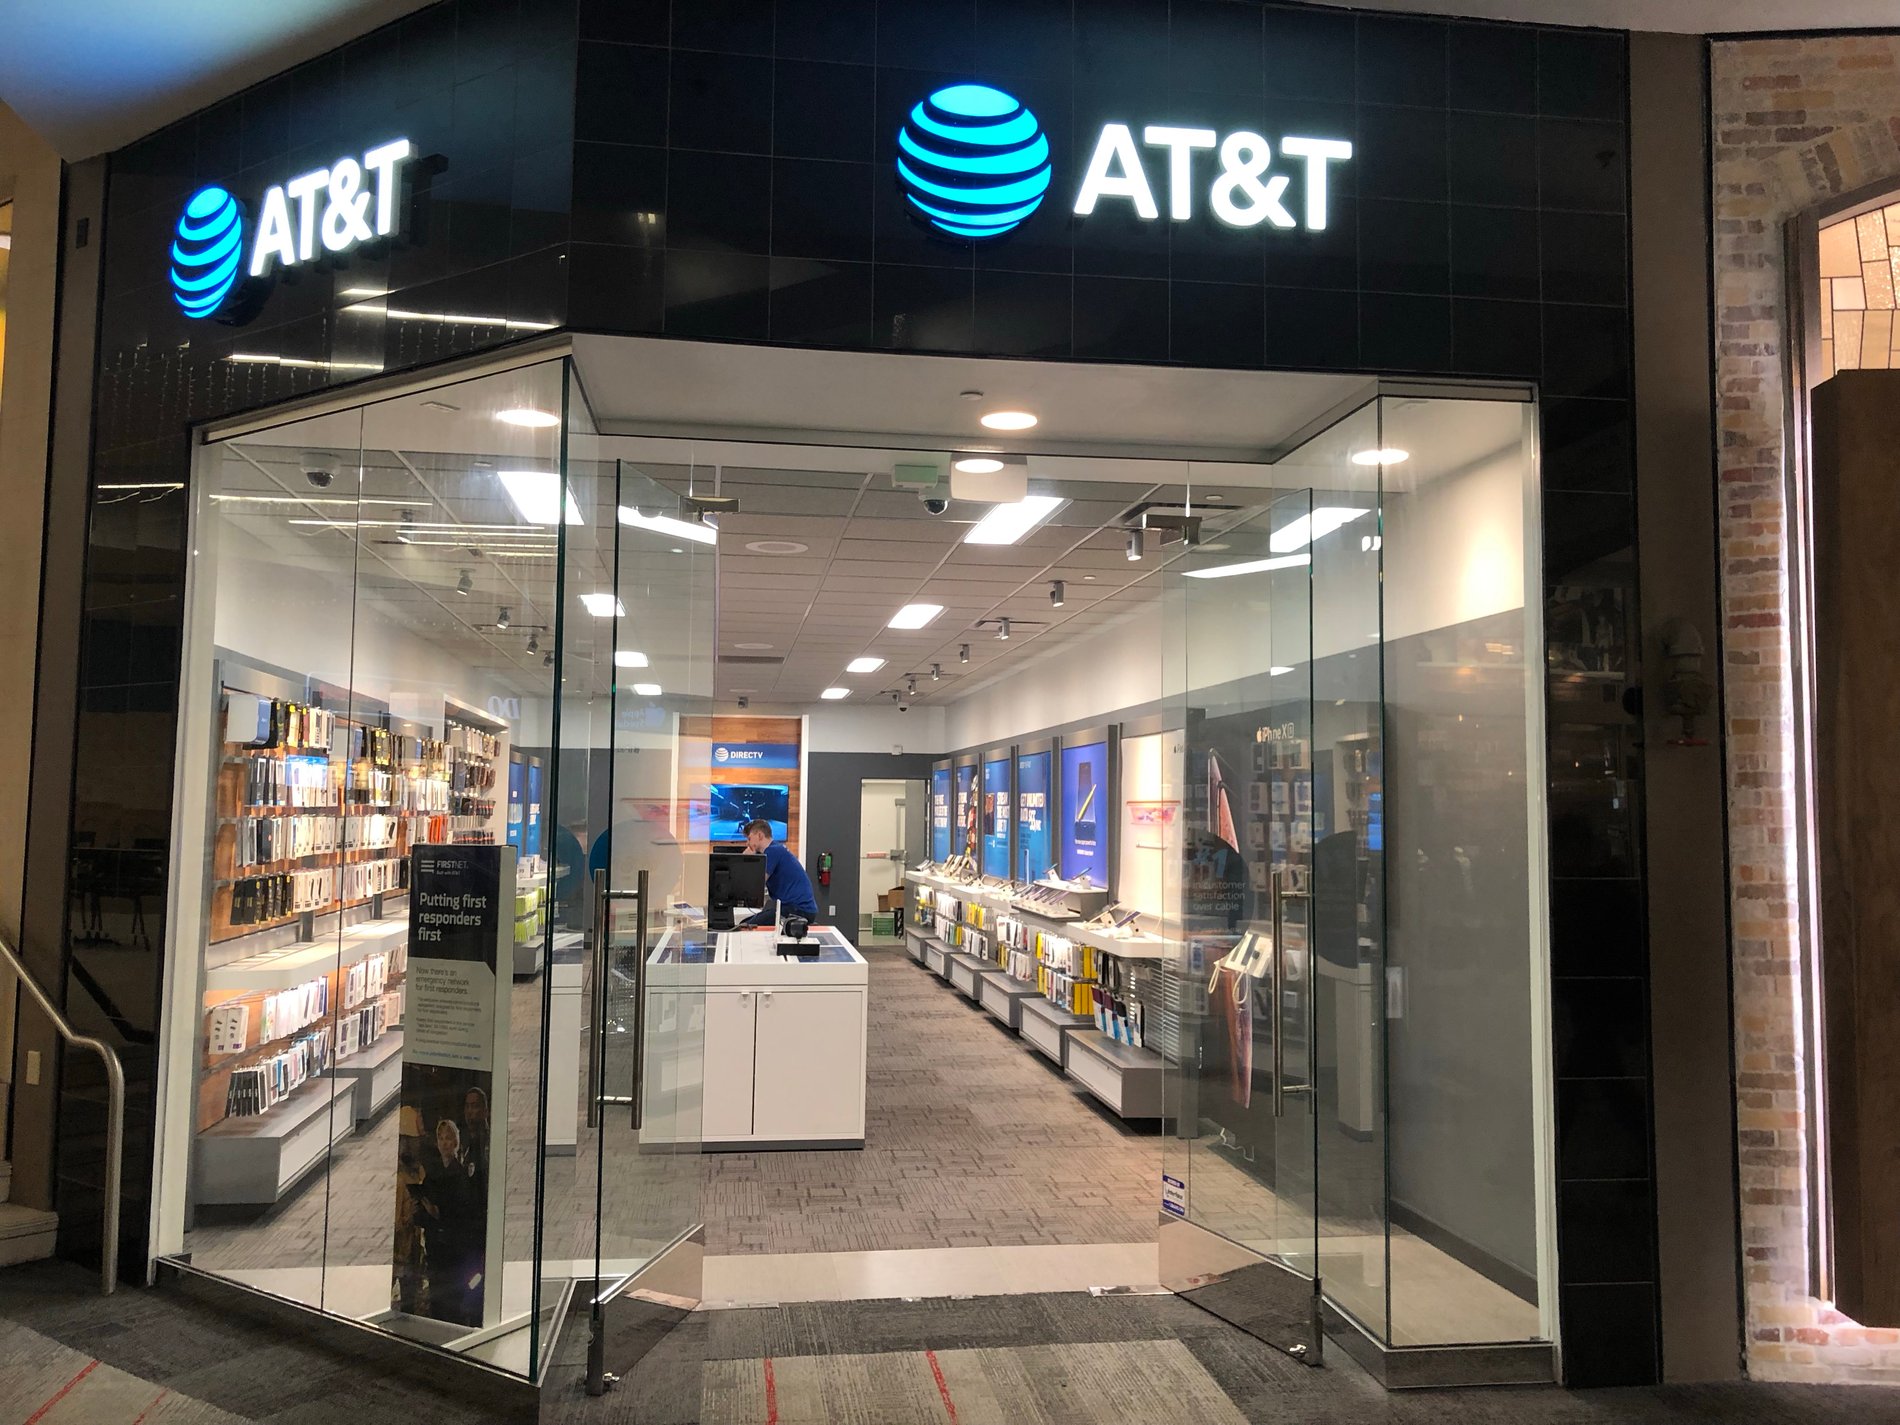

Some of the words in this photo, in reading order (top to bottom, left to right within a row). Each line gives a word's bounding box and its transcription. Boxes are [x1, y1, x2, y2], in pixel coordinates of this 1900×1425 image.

[1073, 123, 1353, 231] AT&T
[250, 138, 411, 277] AT&T
[730, 751, 764, 759] DIRECTV
[1201, 881, 1246, 890] customer
[1192, 890, 1246, 900] satisfaction
[419, 892, 460, 910] Putting
[462, 894, 487, 909] first
[1192, 902, 1213, 910] over
[1215, 902, 1239, 911] cable
[418, 911, 482, 927] responders
[417, 927, 442, 942] first
[415, 966, 429, 975] Now
[415, 976, 446, 985] emergency
[424, 984, 435, 992] first
